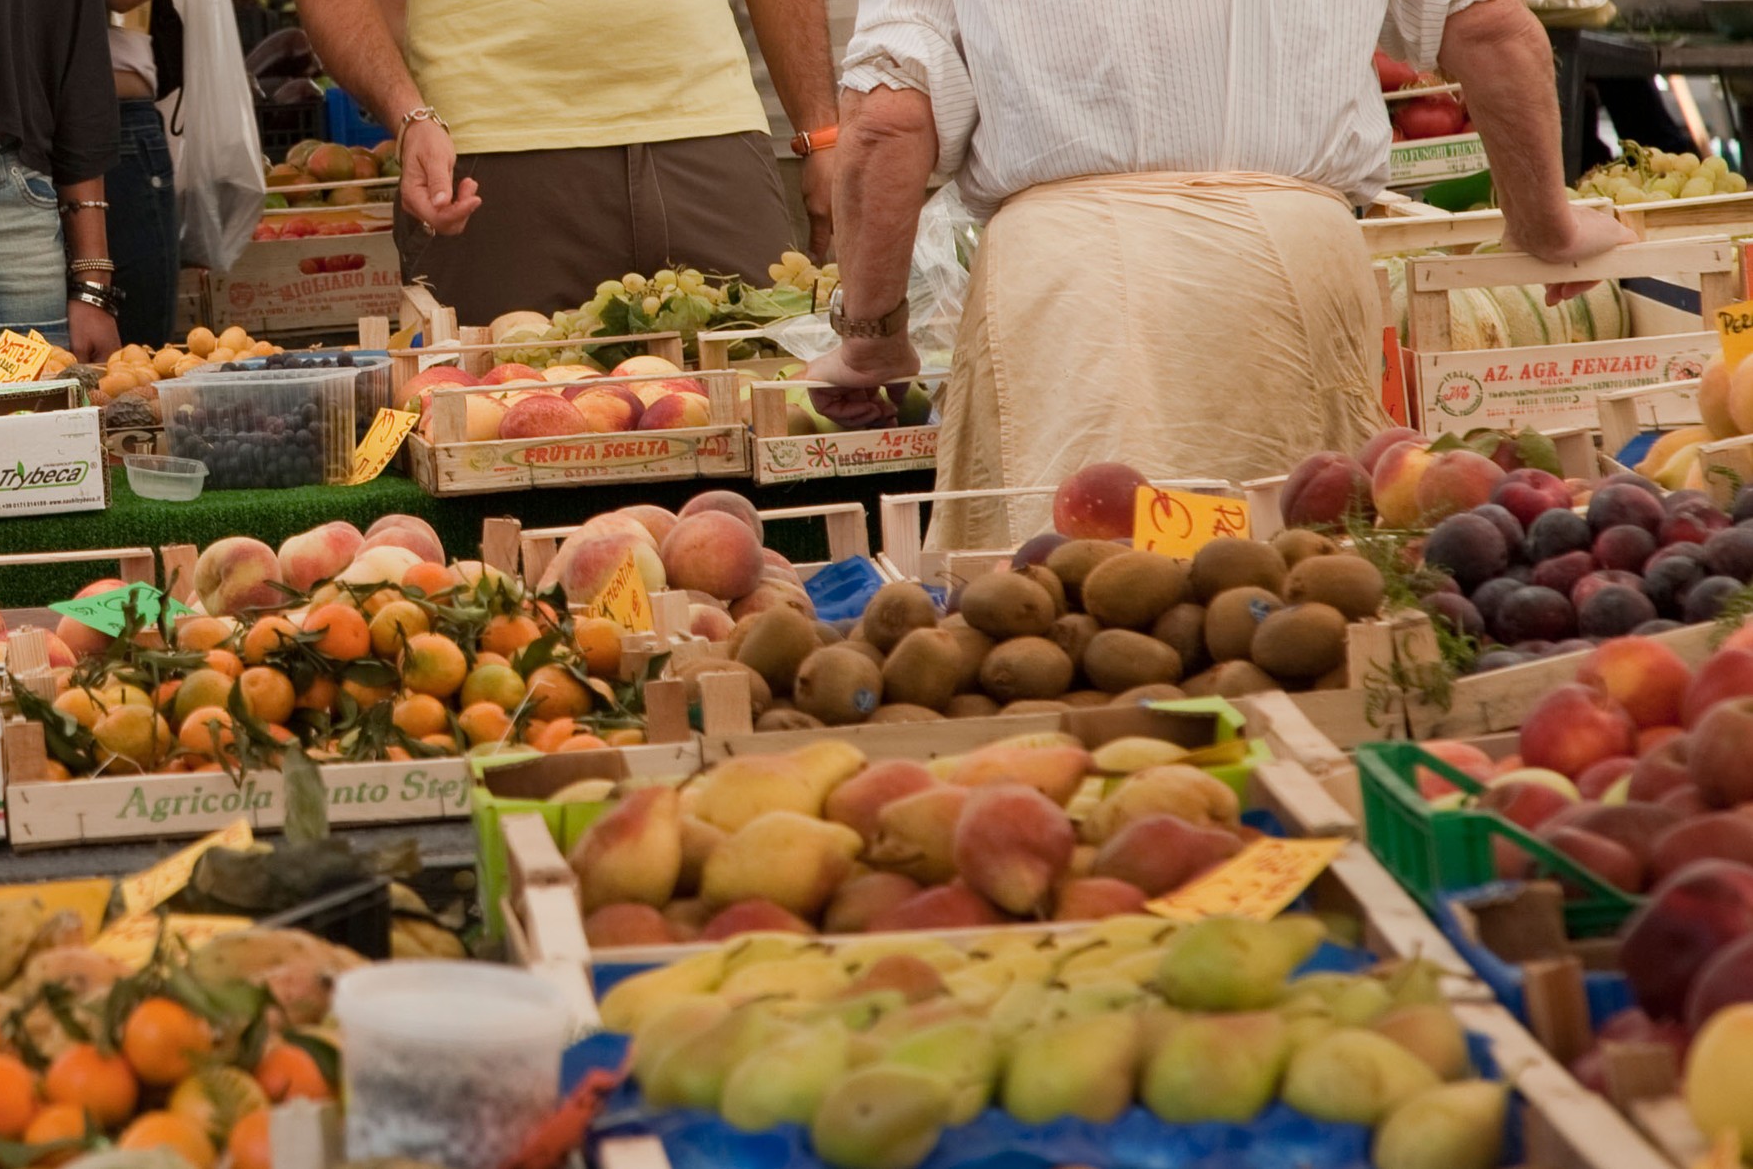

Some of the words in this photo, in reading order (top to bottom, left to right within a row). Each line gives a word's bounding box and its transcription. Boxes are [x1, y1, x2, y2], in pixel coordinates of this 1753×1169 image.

[1410, 145, 1447, 162] FUNGHI
[1483, 365, 1513, 383] AZ.
[1519, 360, 1564, 381] AGR.
[1571, 355, 1658, 376] FENZATO
[524, 444, 596, 463] FRUTTA
[602, 440, 669, 457] SCELTA
[116, 780, 273, 823] Agricola
